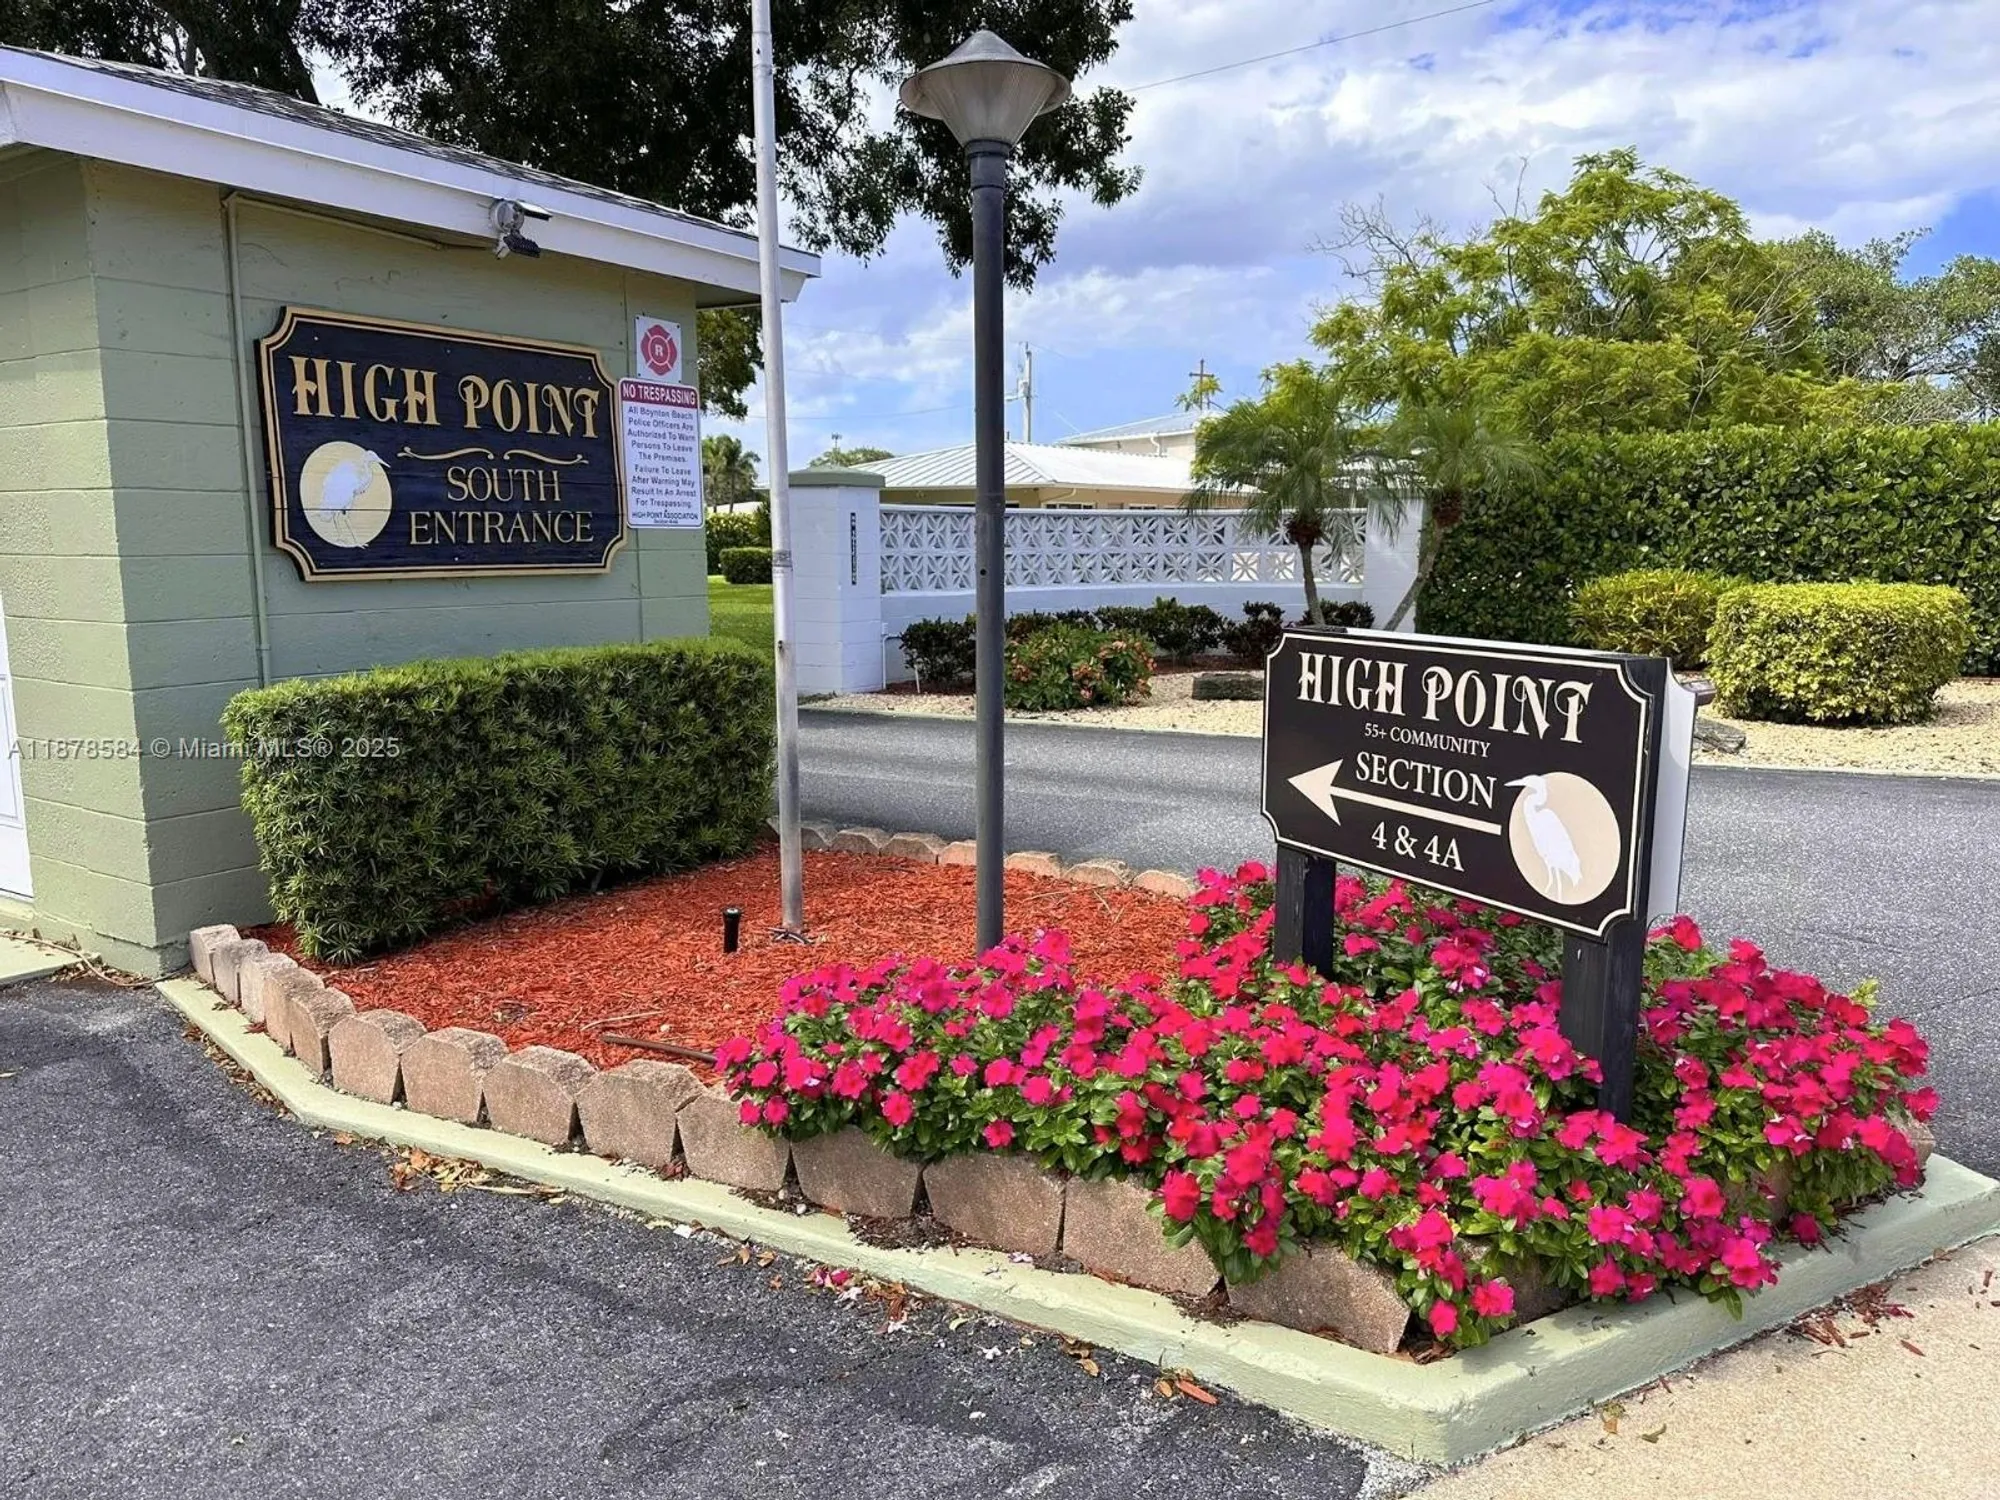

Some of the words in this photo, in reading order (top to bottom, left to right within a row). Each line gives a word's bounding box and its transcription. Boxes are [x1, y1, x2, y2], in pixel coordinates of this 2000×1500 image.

[655, 343, 664, 357] R
[289, 355, 441, 426] HIGH
[457, 374, 600, 439] POINT
[622, 383, 637, 398] NO
[638, 385, 695, 405] TRESPASSING
[628, 406, 639, 414] All
[640, 406, 670, 418] Boynton
[672, 410, 693, 420] Beach
[628, 417, 651, 427] Police
[653, 419, 680, 430] Officers
[682, 423, 694, 431] Are
[627, 428, 667, 439] Authorized
[668, 432, 677, 440] To
[678, 433, 696, 441] Warn
[631, 440, 661, 449] Persons
[662, 443, 671, 451] To
[673, 443, 693, 452] Leave
[638, 452, 652, 460] The
[634, 464, 659, 473] Failure
[661, 466, 670, 474] To
[672, 467, 691, 475] Leave
[447, 466, 562, 503] SOUTH
[632, 475, 649, 484] After
[651, 477, 680, 487] Warning
[681, 478, 695, 488] May
[631, 487, 654, 496] Result
[656, 488, 663, 496] In
[676, 489, 697, 498] Arrest
[635, 498, 648, 506] For
[647, 511, 663, 519] POINT
[664, 512, 698, 520] ASSOCIATION
[409, 511, 595, 546] ENTRANCE
[1297, 651, 1408, 716] HIGH
[1422, 665, 1594, 744] POINT
[1364, 722, 1387, 740] 55+
[1390, 726, 1491, 758] COMMUNITY
[1355, 751, 1498, 810] SECTION
[1371, 821, 1387, 850] 4
[1394, 825, 1418, 859] &
[1424, 834, 1465, 872] 4A
